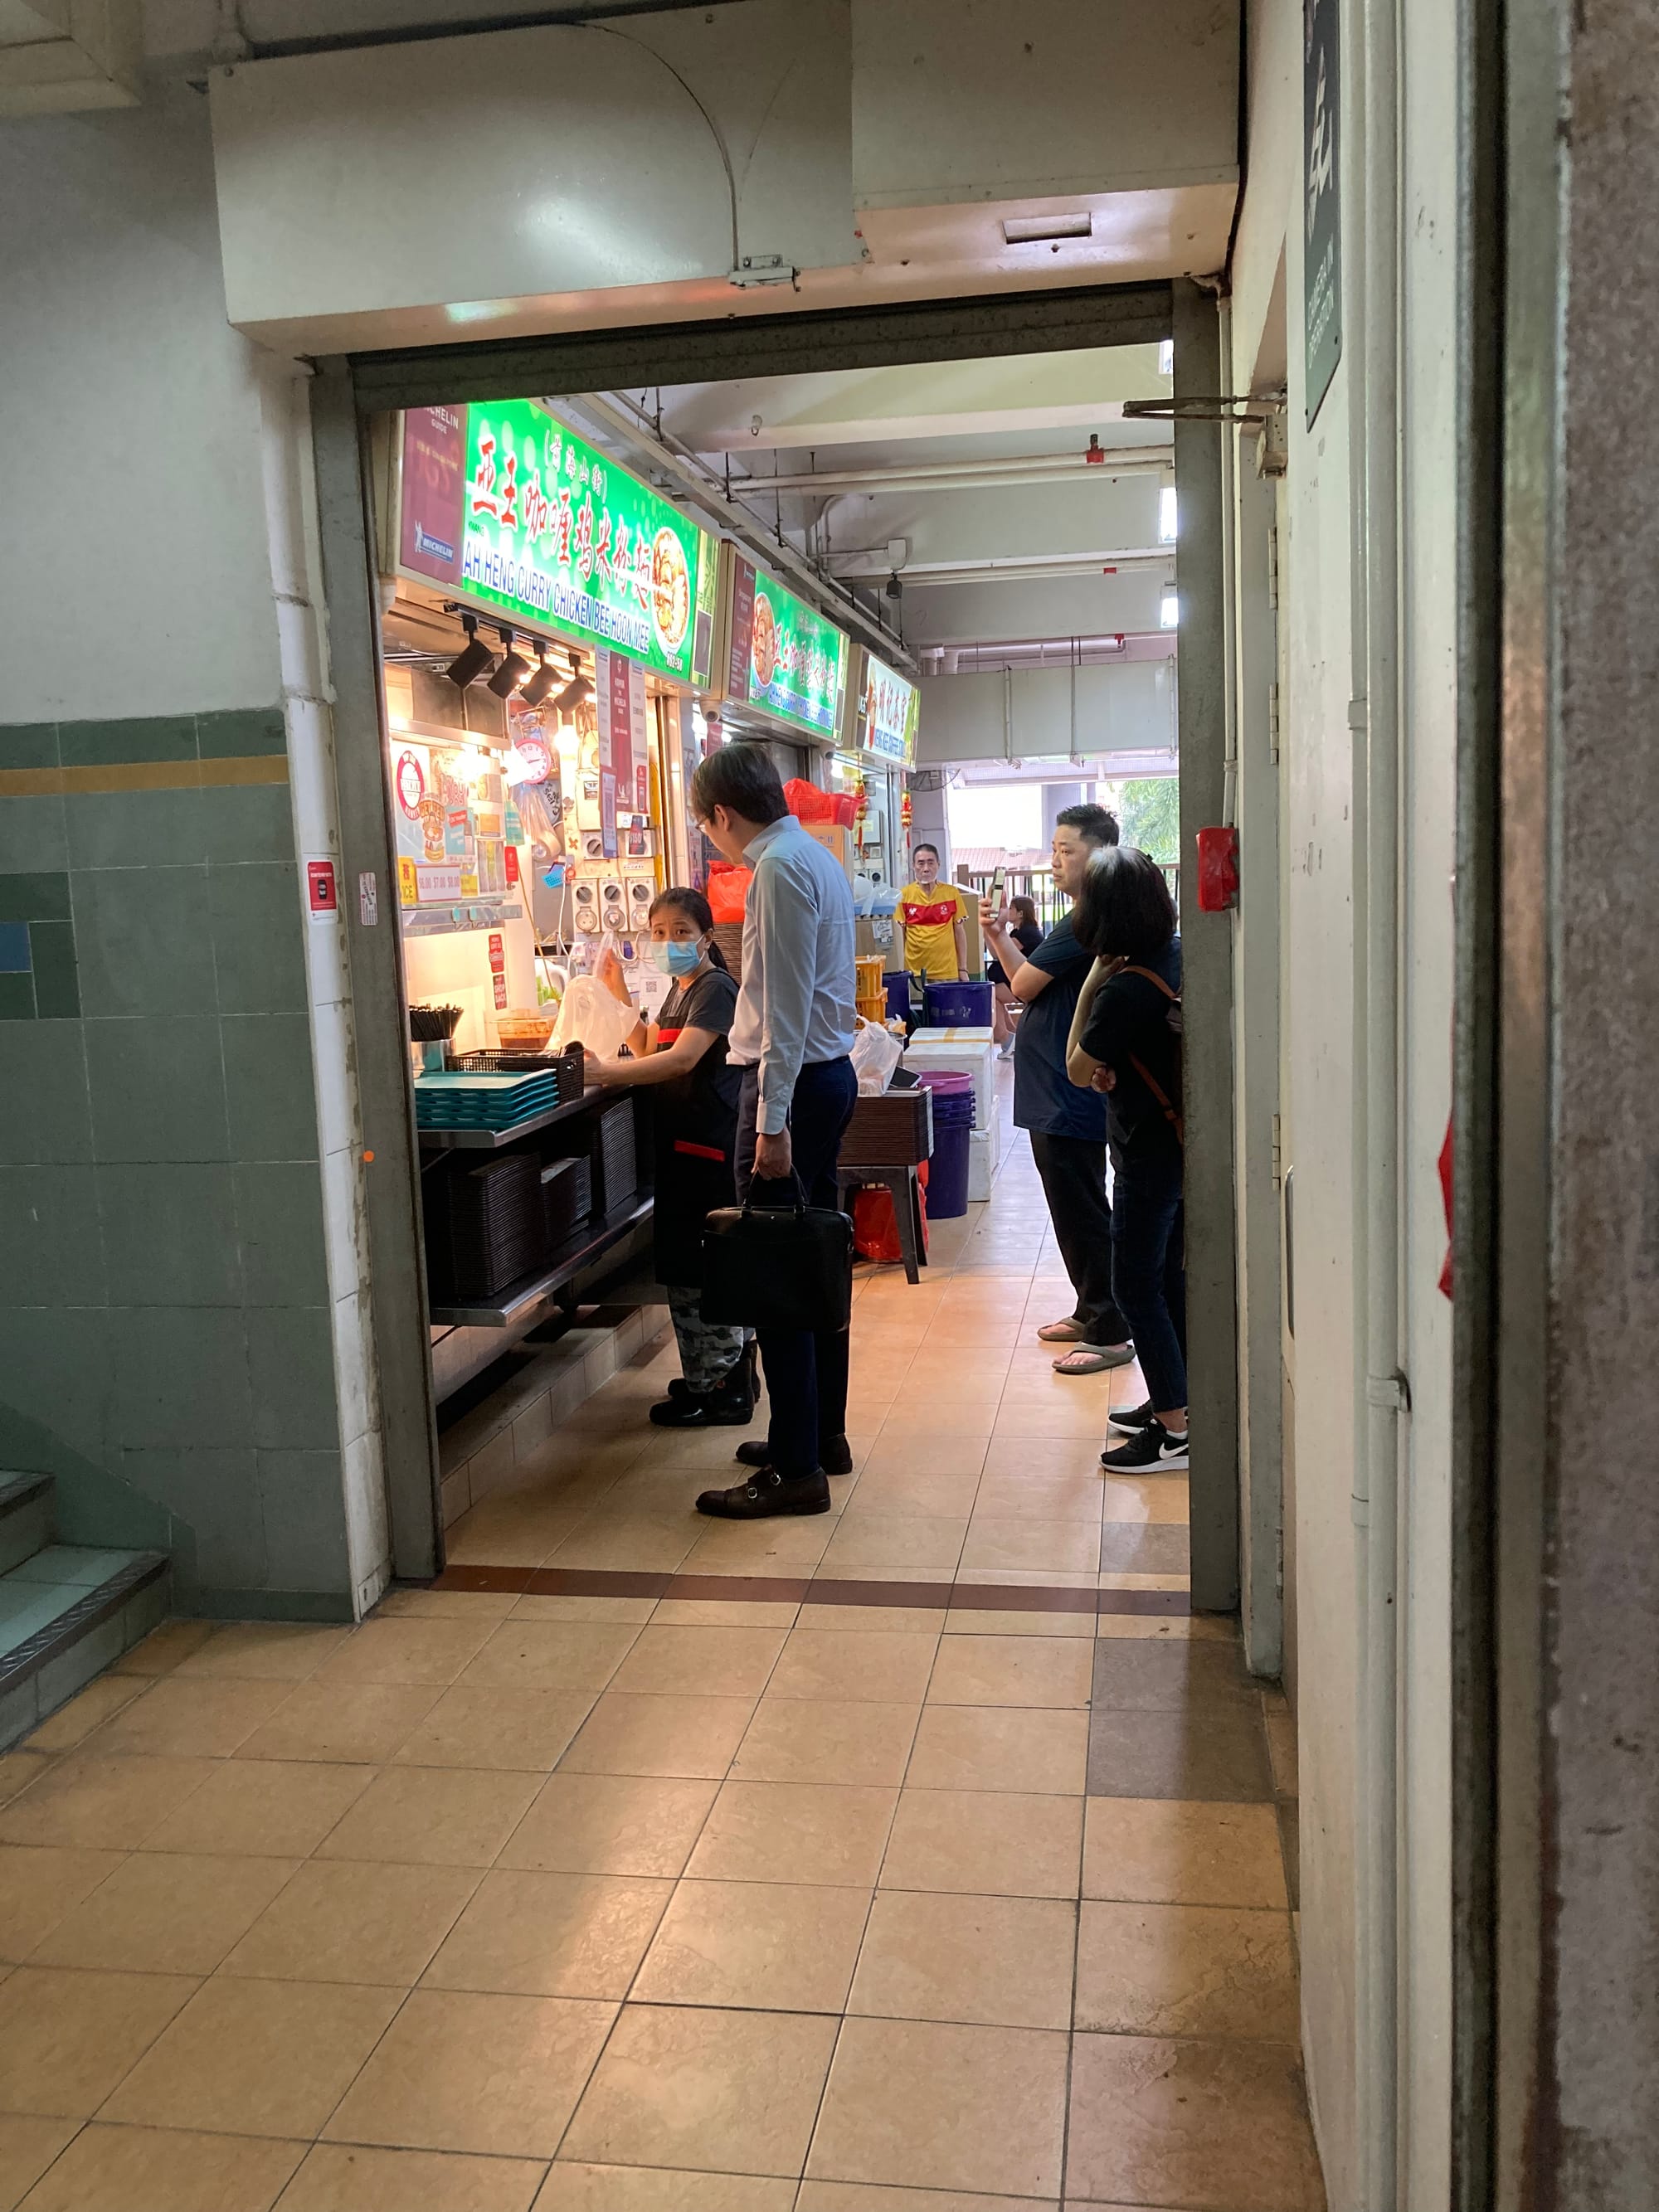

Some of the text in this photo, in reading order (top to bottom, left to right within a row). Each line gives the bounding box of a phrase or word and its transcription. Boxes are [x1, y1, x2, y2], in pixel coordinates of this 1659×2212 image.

[431, 418, 447, 435] GUIDE
[423, 537, 453, 559] MICHELIN
[463, 541, 650, 653] AH HENG CURRY CHICKEN BEE HOON MEE
